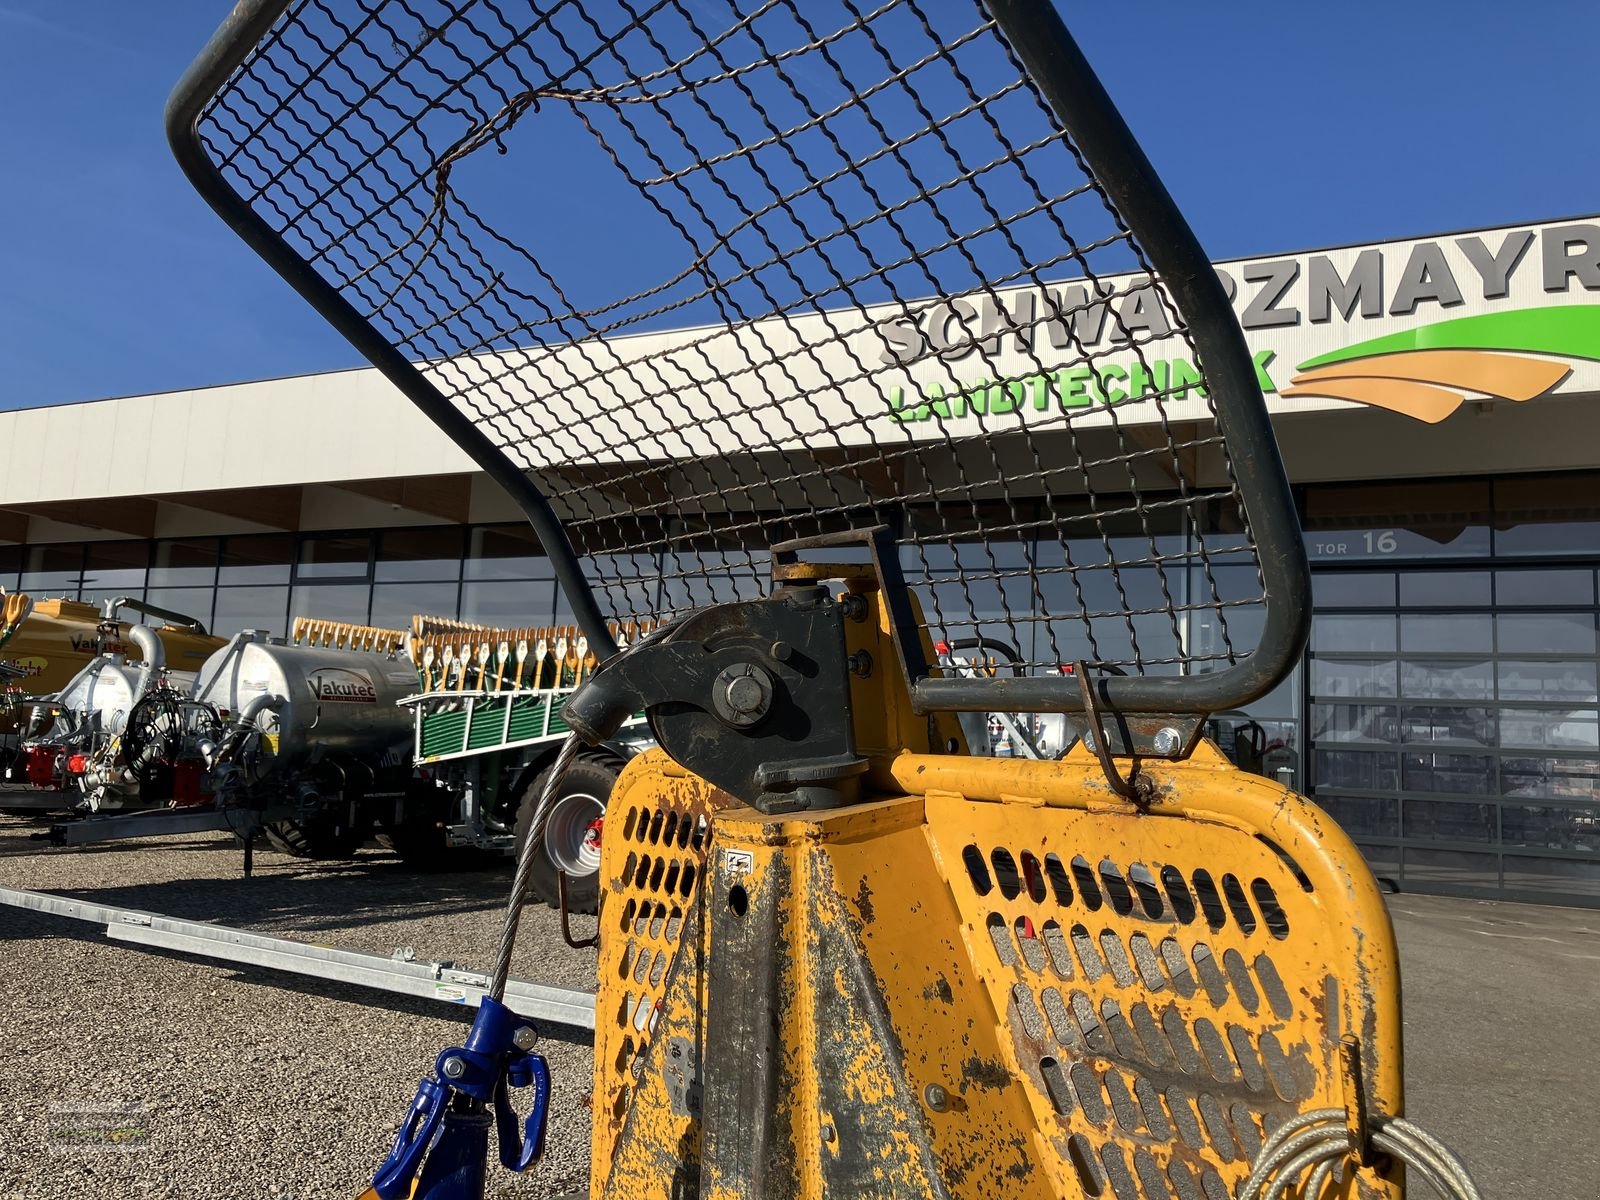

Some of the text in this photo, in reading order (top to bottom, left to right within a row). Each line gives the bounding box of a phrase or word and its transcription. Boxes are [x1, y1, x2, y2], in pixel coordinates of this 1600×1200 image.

[879, 224, 1600, 365] SCHWAZMAYR
[889, 350, 1278, 423] LANDTECHNK
[1315, 531, 1397, 554] TOR 16
[307, 676, 376, 700] Vakutec
